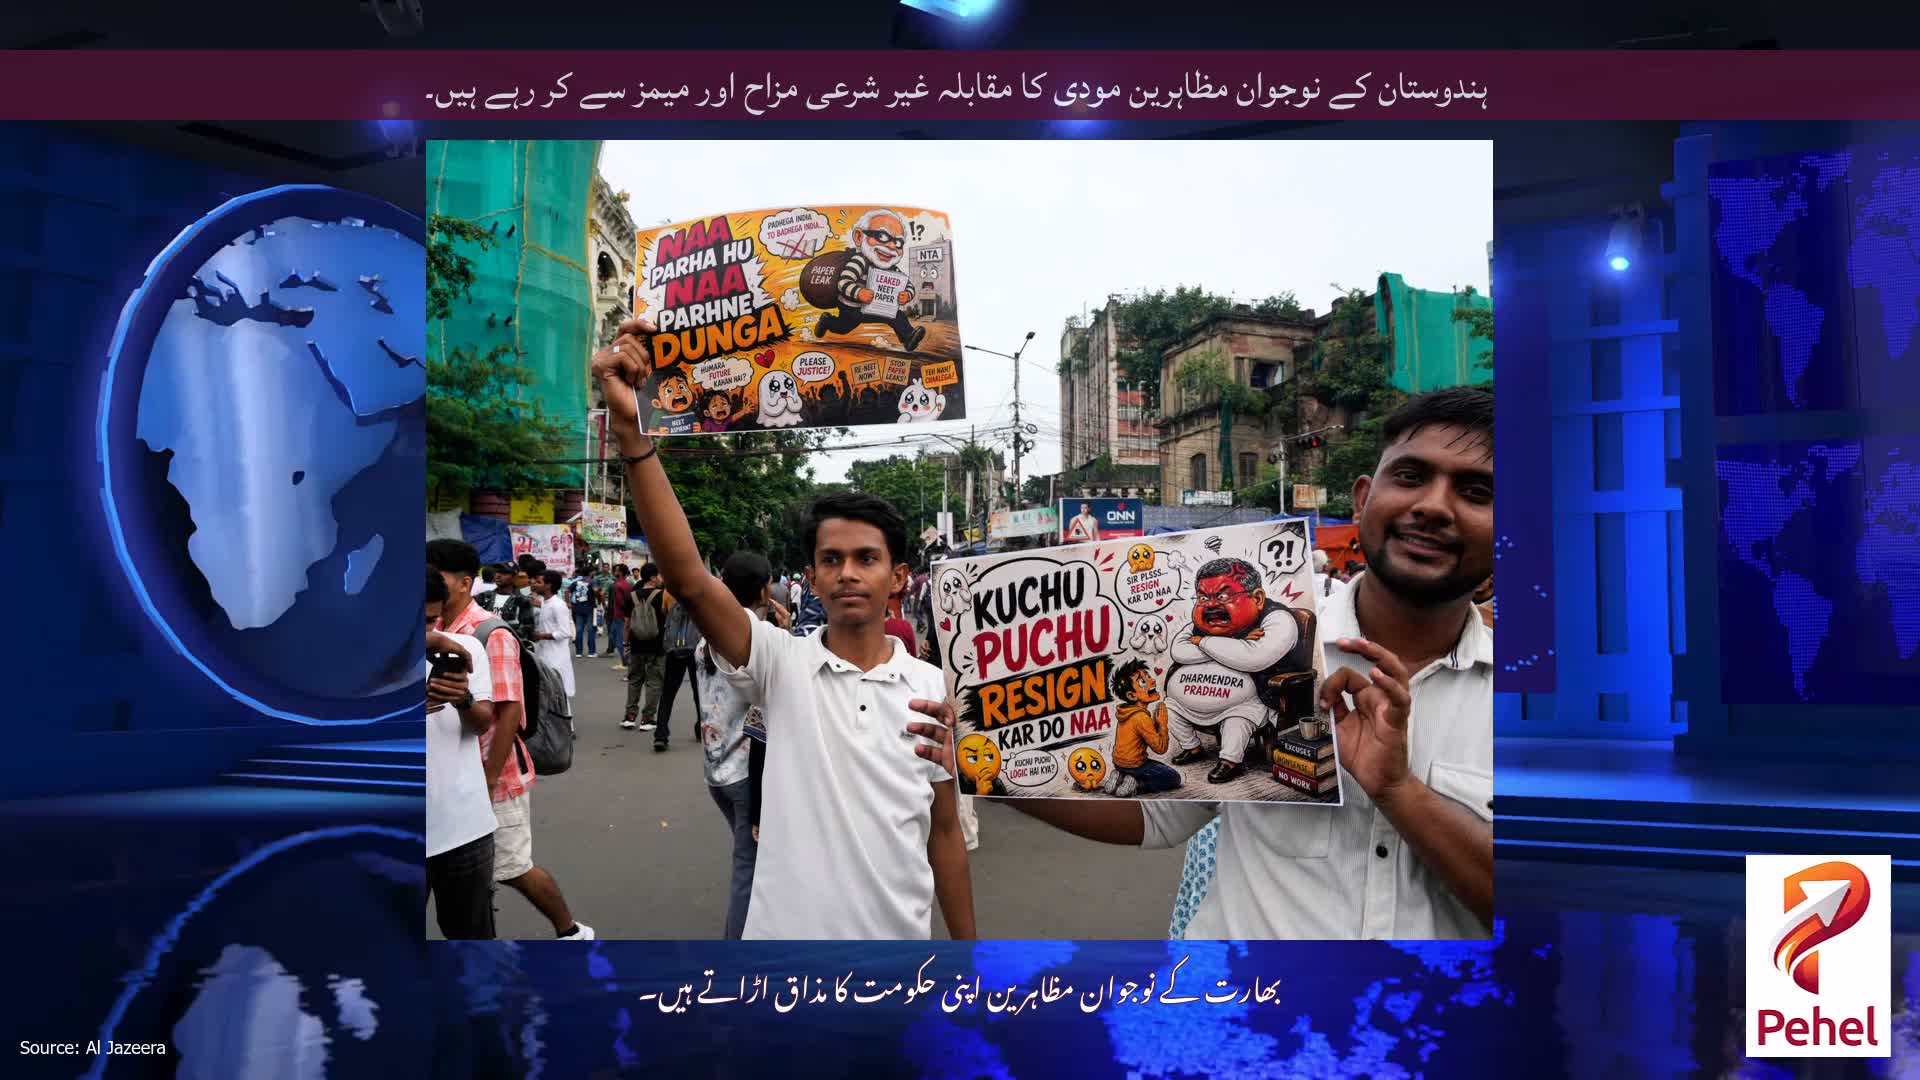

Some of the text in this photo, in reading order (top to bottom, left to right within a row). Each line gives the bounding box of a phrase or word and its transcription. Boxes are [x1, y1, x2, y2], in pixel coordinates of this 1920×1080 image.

[767, 213, 812, 229] PADHEGA INDIA
[767, 230, 776, 239] TO
[776, 225, 803, 237] BADHEGA
[656, 215, 732, 265] NAA
[919, 249, 939, 261] NTA
[651, 238, 752, 288] PARHA HU
[811, 265, 836, 275] PAPER
[665, 263, 746, 309] NAA
[810, 275, 832, 285] LEAK
[875, 273, 901, 287] LEAKED
[877, 284, 895, 295] NEET
[874, 293, 895, 304] PAPER
[659, 292, 753, 333] PARHNE
[652, 306, 784, 369] DUNGA
[700, 361, 726, 374] HUMARA
[799, 356, 827, 366] PLEASE
[890, 360, 906, 368] STOP
[708, 368, 732, 381] FUTURE
[797, 365, 831, 376] JUSTICE!
[885, 372, 907, 382] LEAKS!
[888, 366, 906, 374] PAPER
[713, 373, 747, 388] KAHAN HAI?
[1107, 510, 1135, 521] ONN
[1267, 540, 1294, 568] ?!
[1126, 574, 1139, 585] SIR
[1130, 579, 1160, 594] RESIGN
[973, 567, 1084, 631] KUCHU
[1127, 586, 1172, 605] KAR DO NAA
[972, 604, 1110, 680] PUCHU
[1180, 673, 1244, 689] DHARMENDRA
[978, 661, 1106, 728] RESIGN
[1183, 684, 1231, 699] PRADHAN
[998, 706, 1112, 751] KAR DO NAA
[1284, 743, 1312, 757] EXCUSES
[1014, 757, 1051, 767] KUCHU PUCHU
[1010, 764, 1055, 779] LOGIC HAI KYA?
[1278, 771, 1311, 791] NO WORK
